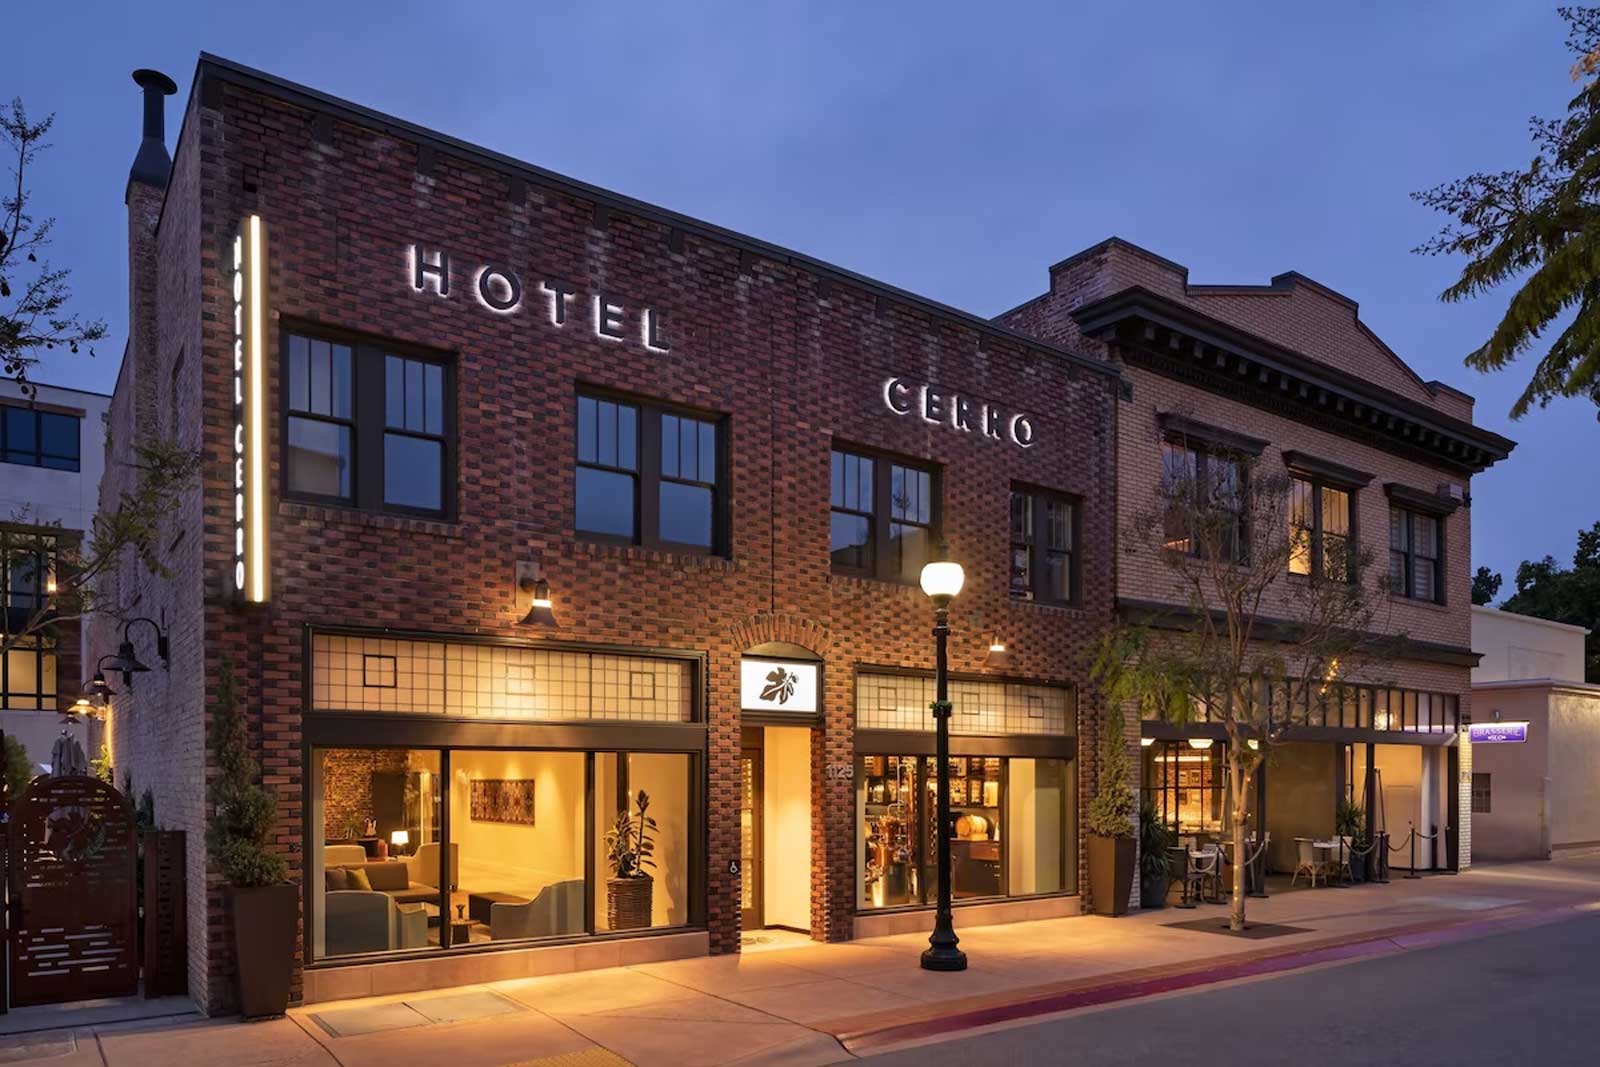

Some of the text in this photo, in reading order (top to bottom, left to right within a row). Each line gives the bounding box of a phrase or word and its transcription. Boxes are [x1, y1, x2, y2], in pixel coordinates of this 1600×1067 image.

[409, 243, 1038, 447] HOTEL CERRO
[234, 235, 244, 591] HOTEL CERRO
[826, 765, 854, 779] 1125
[1472, 726, 1521, 737] BRASSERIE
